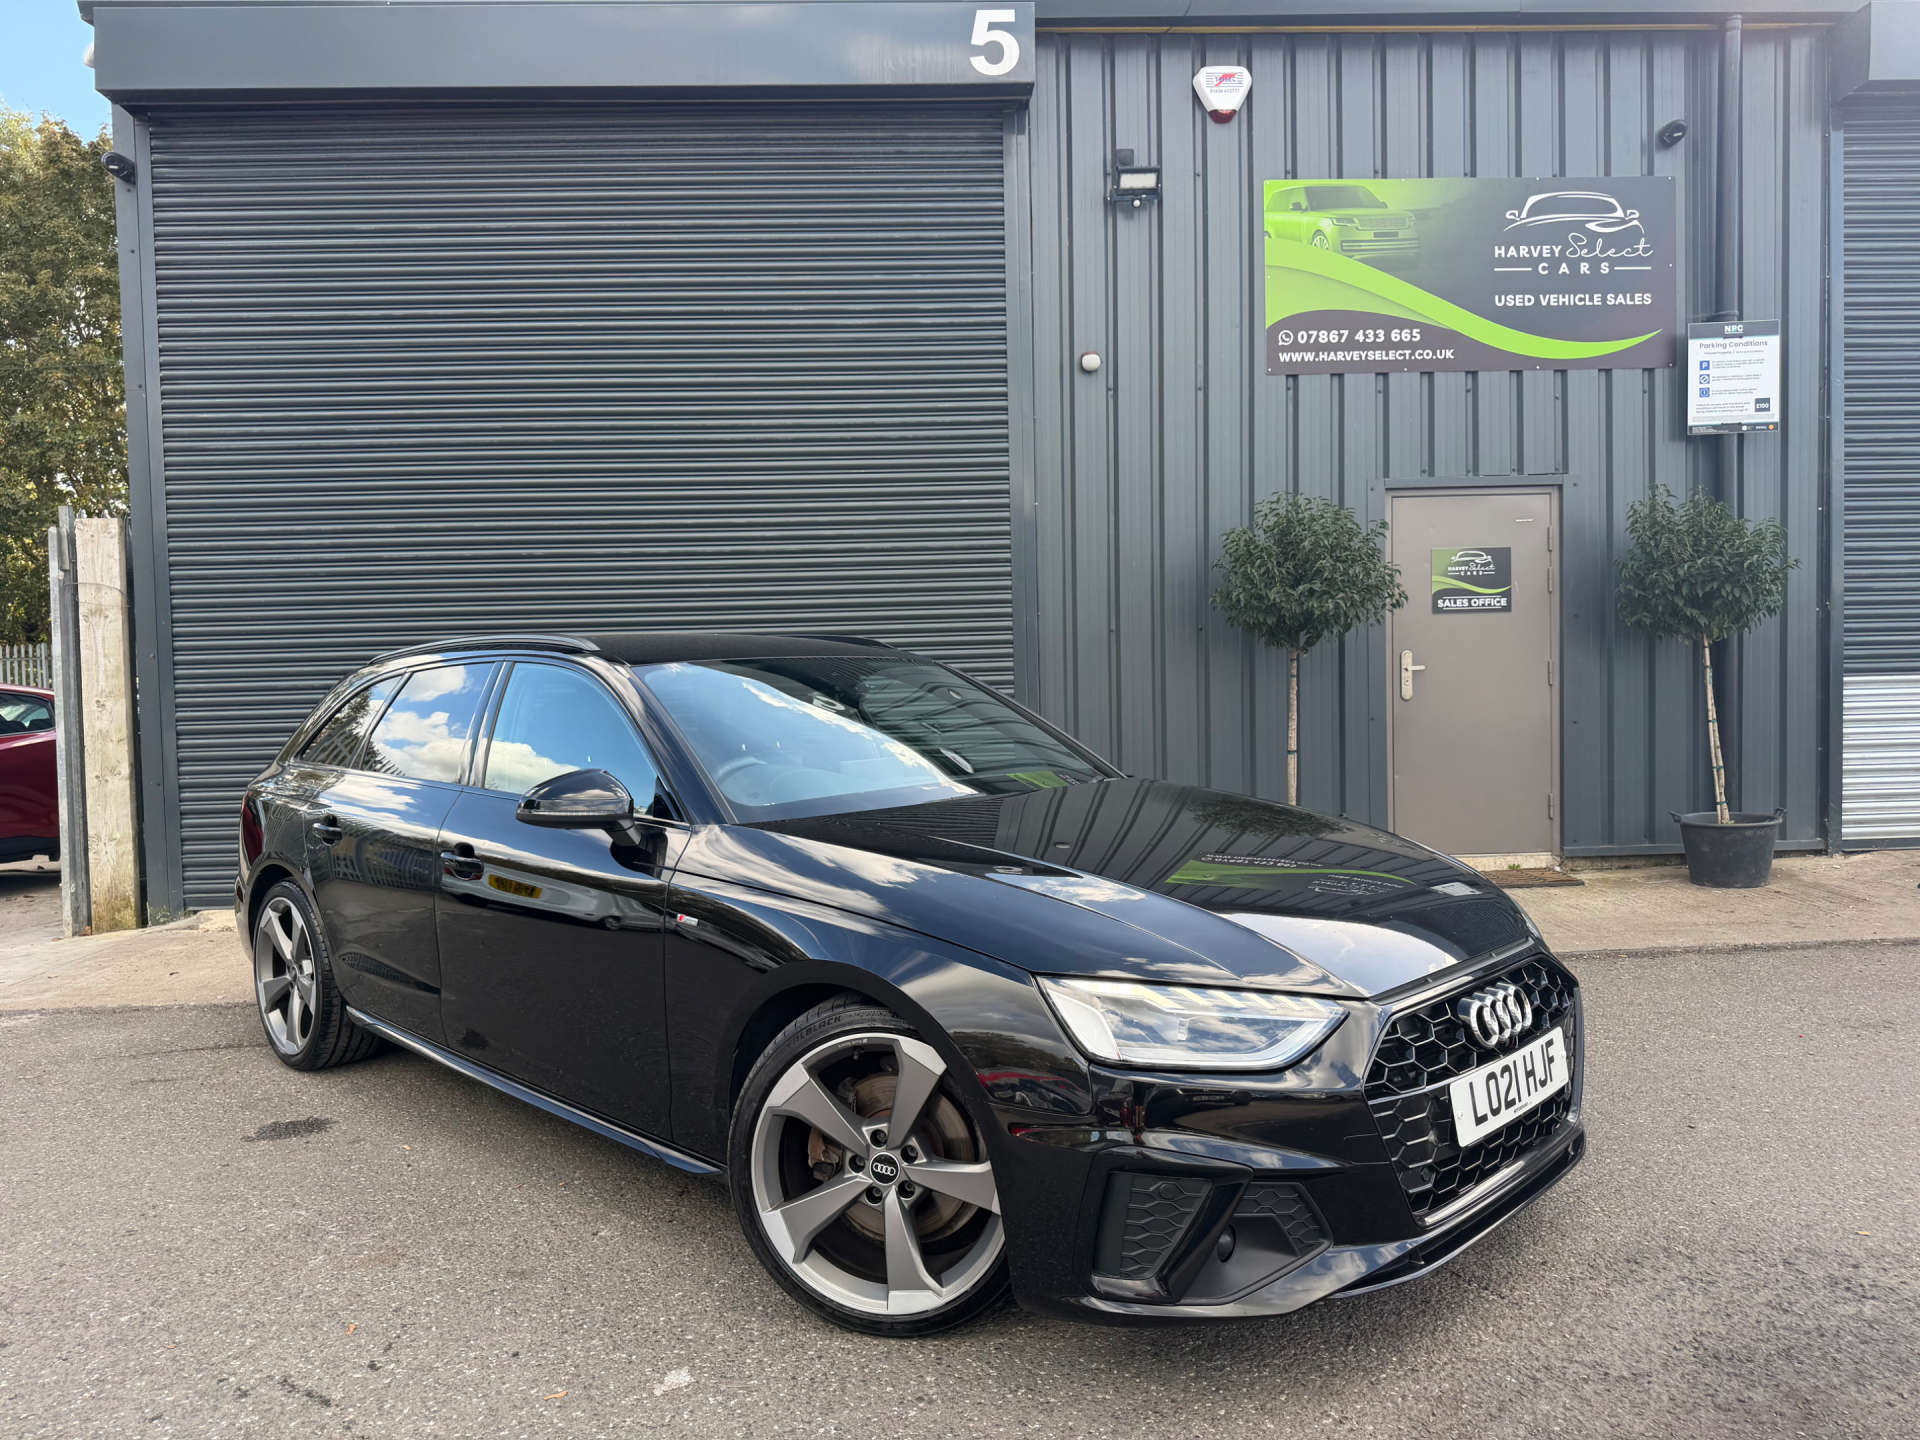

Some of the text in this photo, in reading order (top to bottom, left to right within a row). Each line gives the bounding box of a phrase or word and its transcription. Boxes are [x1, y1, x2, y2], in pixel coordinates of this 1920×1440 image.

[969, 9, 1020, 76] 5
[1494, 232, 1654, 258] HARVEY Select
[1538, 261, 1610, 275] CARS
[1494, 292, 1652, 307] USED VEHICLE SALES
[1297, 328, 1421, 344] 07867 433 665
[1699, 339, 1768, 350] Parking Conditions
[1278, 348, 1455, 363] WWW.HARVEYSELECT.CO.UK
[1437, 597, 1507, 608] SALES OFFICE
[1523, 1037, 1556, 1098] HJF
